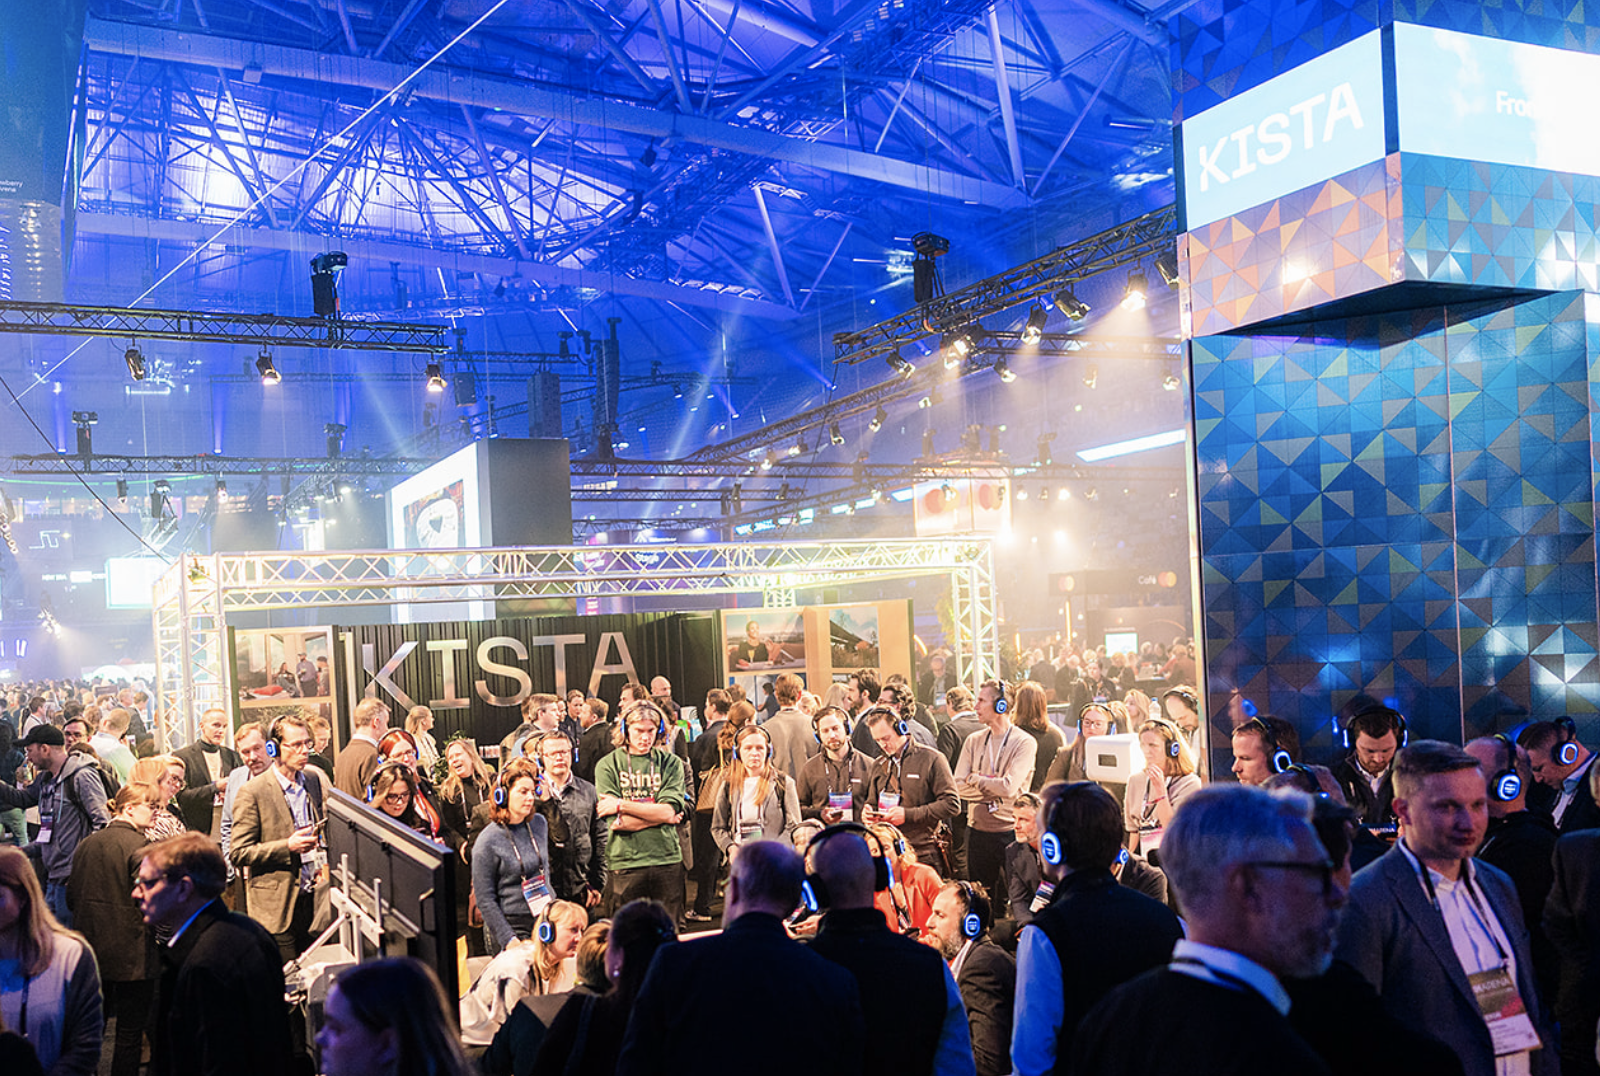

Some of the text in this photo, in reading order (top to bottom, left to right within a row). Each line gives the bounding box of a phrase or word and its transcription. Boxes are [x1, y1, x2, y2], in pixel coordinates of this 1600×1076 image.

[1199, 82, 1364, 191] KISTA
[361, 631, 641, 713] KISTA
[619, 769, 663, 792] Sting
